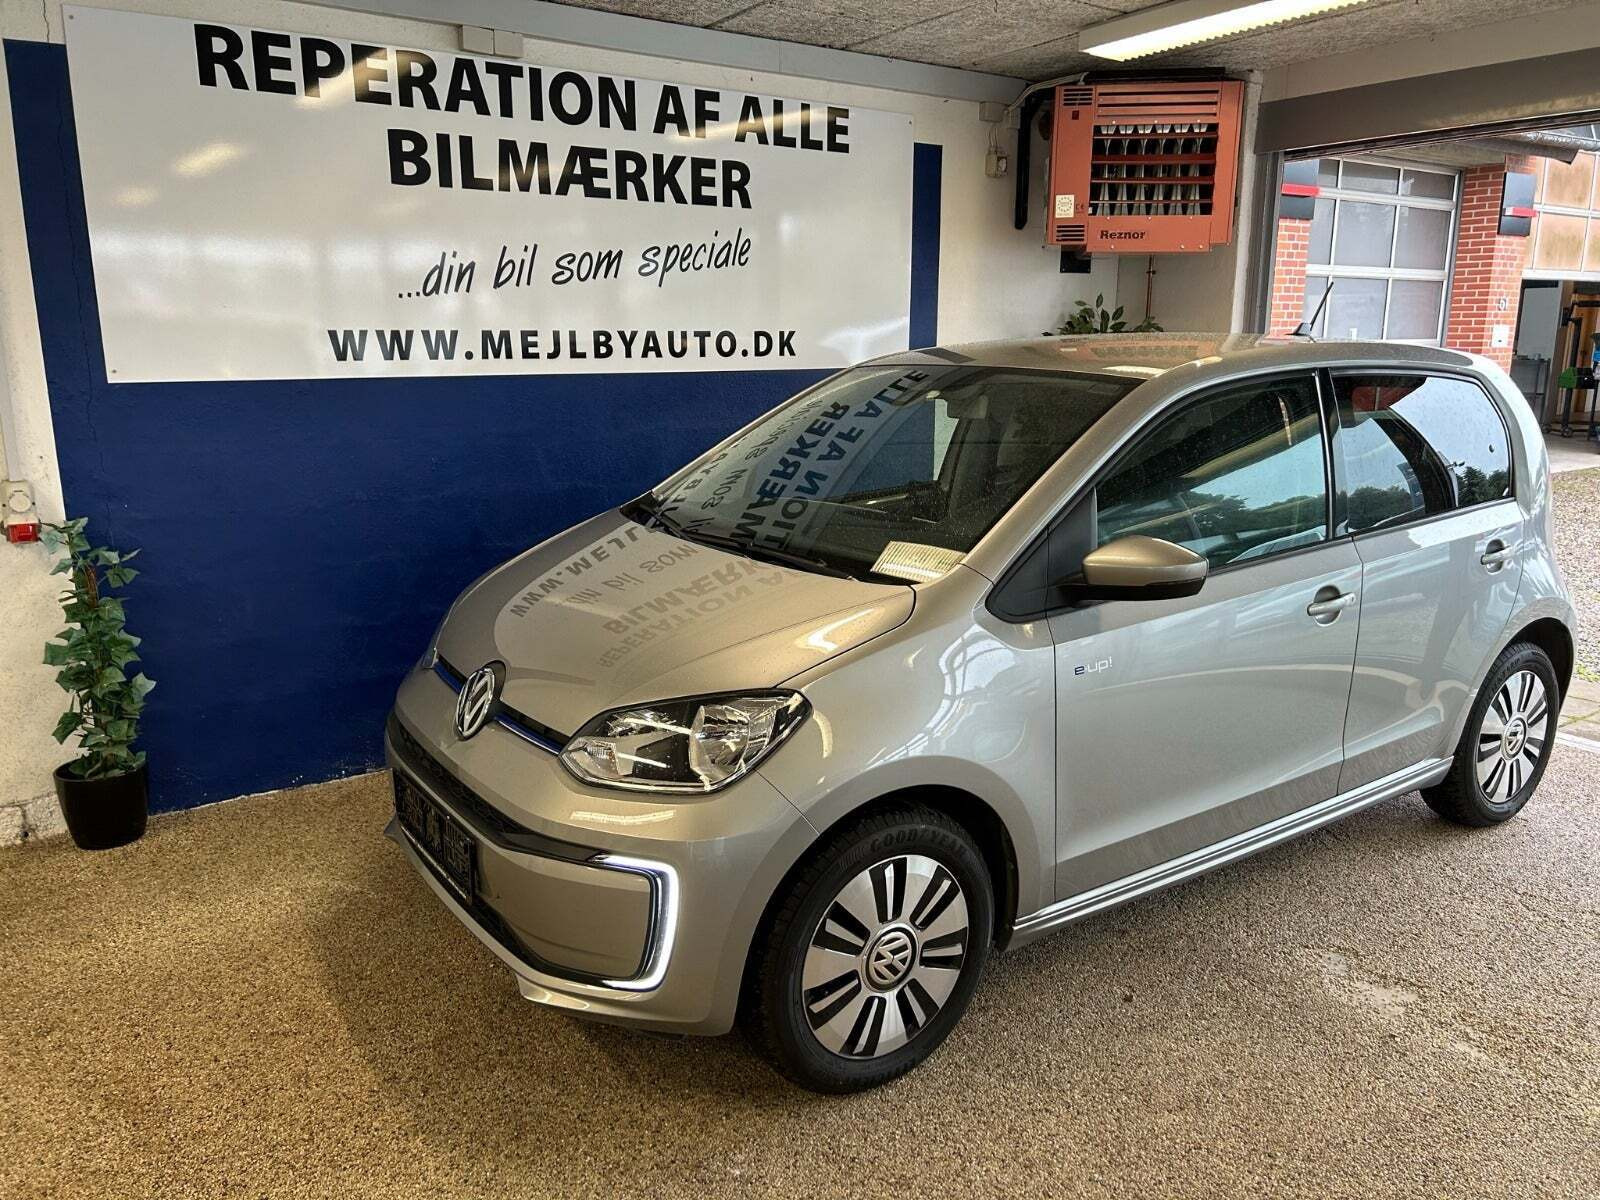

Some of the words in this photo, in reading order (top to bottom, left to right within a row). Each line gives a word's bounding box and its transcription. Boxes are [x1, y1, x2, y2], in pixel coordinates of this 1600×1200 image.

[193, 23, 638, 132] REPERATION
[652, 84, 721, 138] AF
[734, 94, 850, 154] ALLE
[387, 128, 752, 209] BILMÆRKER
[492, 243, 538, 290] bil
[551, 248, 624, 285] som
[637, 227, 752, 288] speciale
[1099, 229, 1146, 240] Reznor
[327, 329, 797, 361] WWW.MEJLBYAUTO.DK
